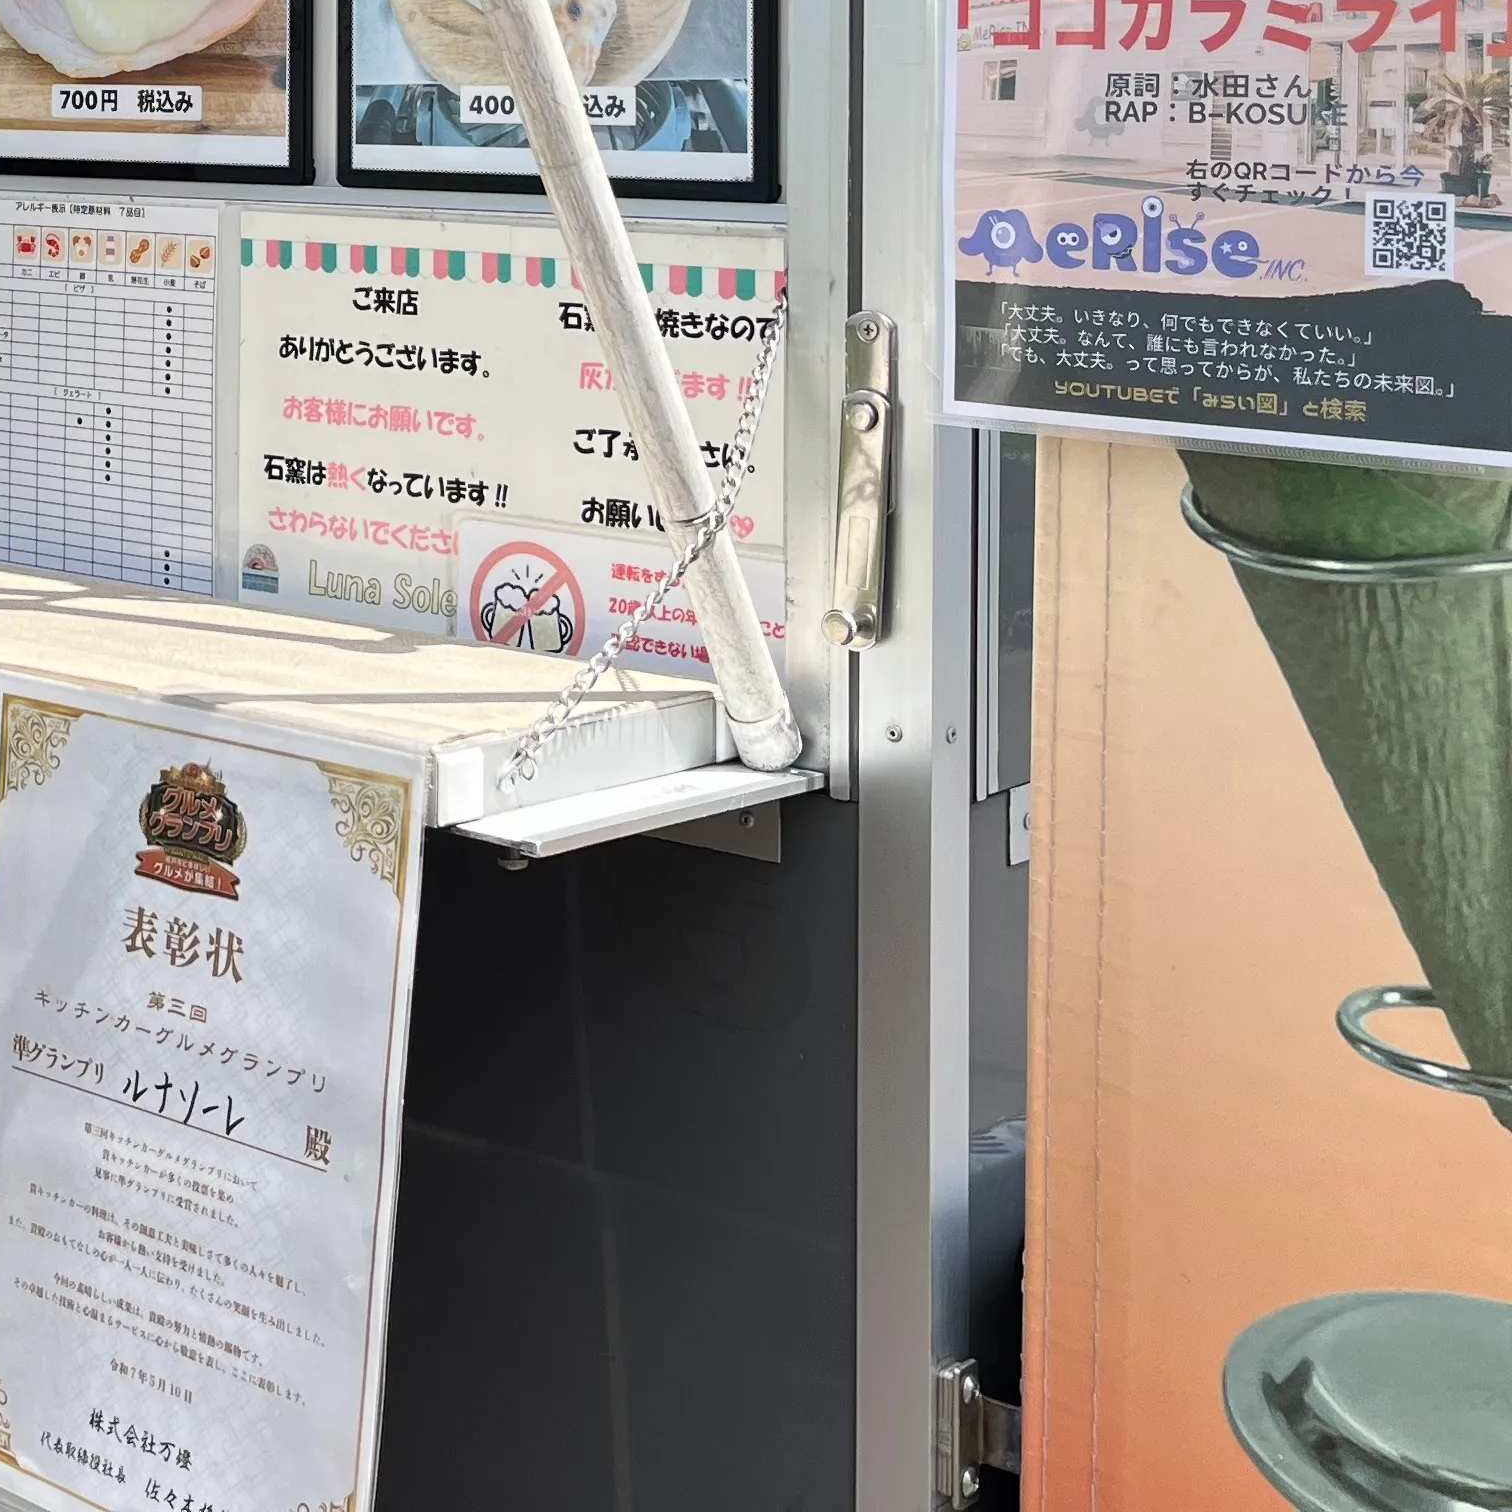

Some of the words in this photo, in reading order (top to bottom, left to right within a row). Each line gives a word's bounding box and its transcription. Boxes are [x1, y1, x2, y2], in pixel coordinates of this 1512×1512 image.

[60, 90, 118, 112] 700円
[137, 89, 193, 113] 税込み
[469, 94, 515, 115] 400
[1186, 159, 1425, 188] 右のQRコードから今
[352, 286, 419, 316] ご来店
[278, 335, 491, 380] ありがとうございます。
[283, 397, 486, 441] お客様にお願いです。
[309, 559, 382, 606] Luna
[393, 579, 458, 617] Sole
[162, 787, 220, 821] グルメ
[149, 810, 232, 851] グランプリ
[120, 905, 245, 984] 表彰状
[147, 990, 207, 1023] 第三回
[34, 989, 326, 1094] キッチンカーグルメグランプリ
[12, 1033, 104, 1085] 準グランプリ
[122, 1069, 245, 1136] ルナソーレ
[304, 1125, 332, 1166] 殿
[40, 1431, 126, 1484] 代表取締役社長
